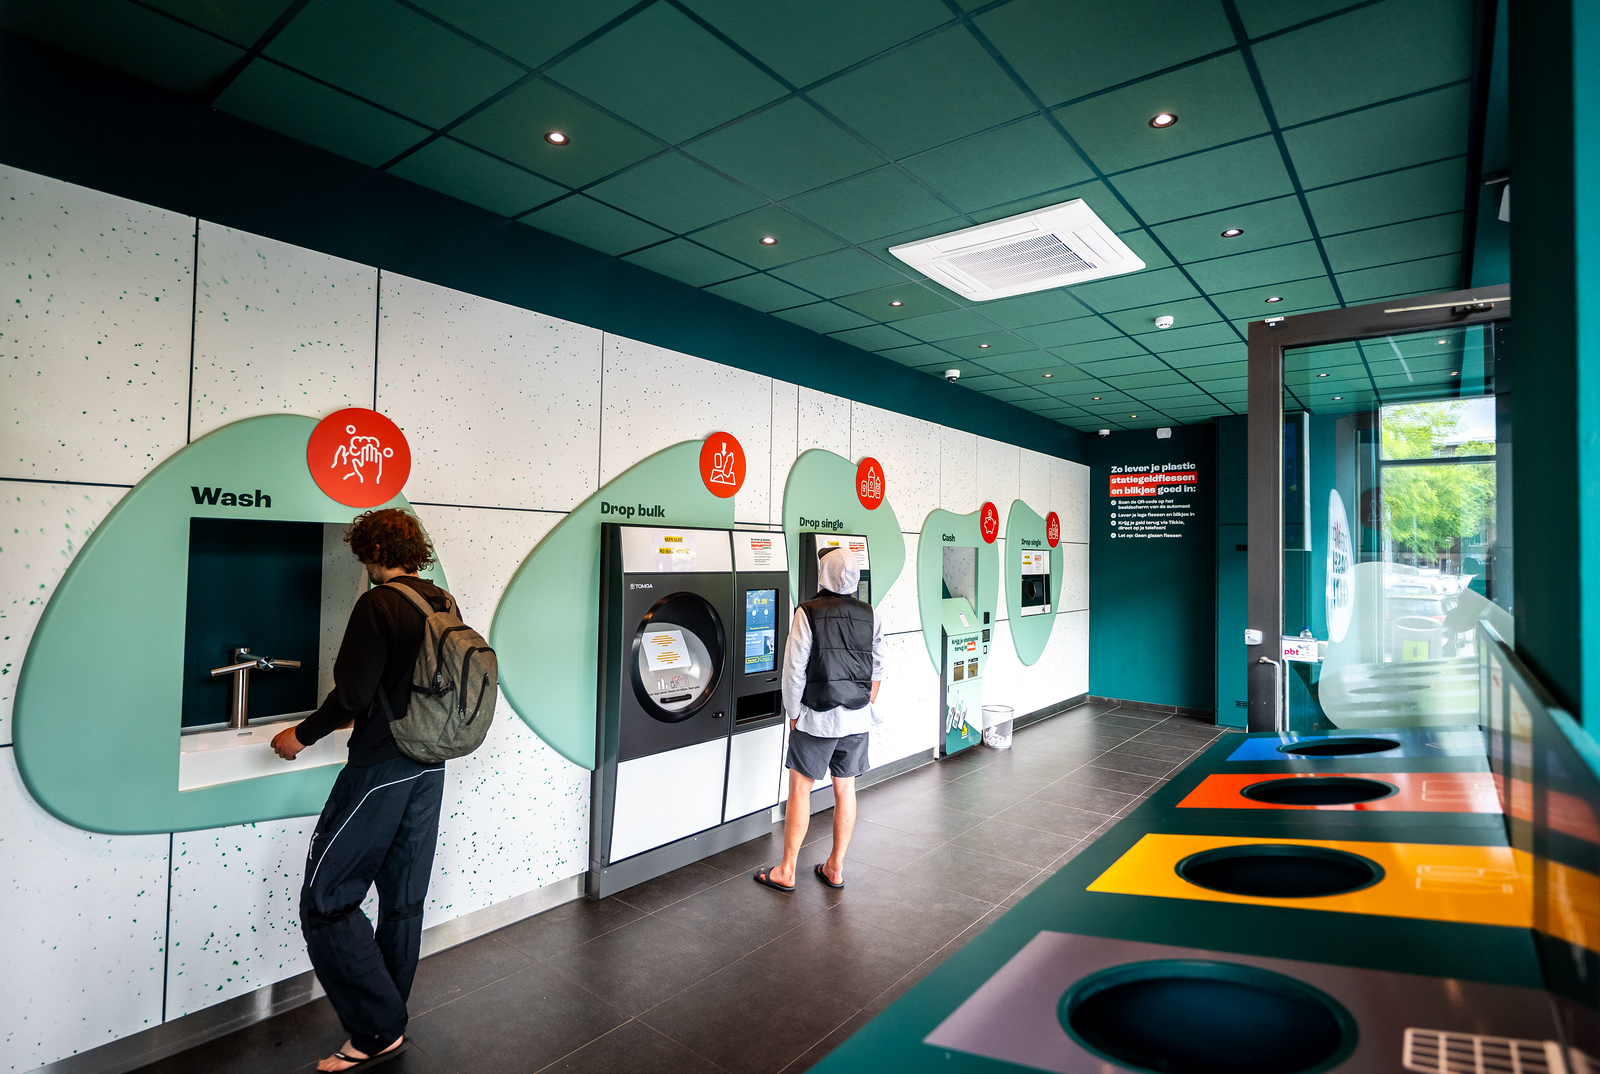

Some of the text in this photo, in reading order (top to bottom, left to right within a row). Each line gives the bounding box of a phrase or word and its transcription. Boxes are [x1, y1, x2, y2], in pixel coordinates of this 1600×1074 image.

[1150, 464, 1160, 473] je
[1161, 462, 1196, 472] plastic
[1111, 474, 1195, 485] statiegeldflessen
[1124, 486, 1155, 496] blikjes
[1157, 485, 1182, 495] goed
[1183, 485, 1196, 493] in:
[191, 486, 271, 508] Wash
[601, 501, 665, 519] Drop bulk
[799, 516, 844, 531] Drop single
[942, 533, 956, 542] Cash
[1021, 538, 1042, 547] Drop single
[1284, 647, 1299, 656] pbt
